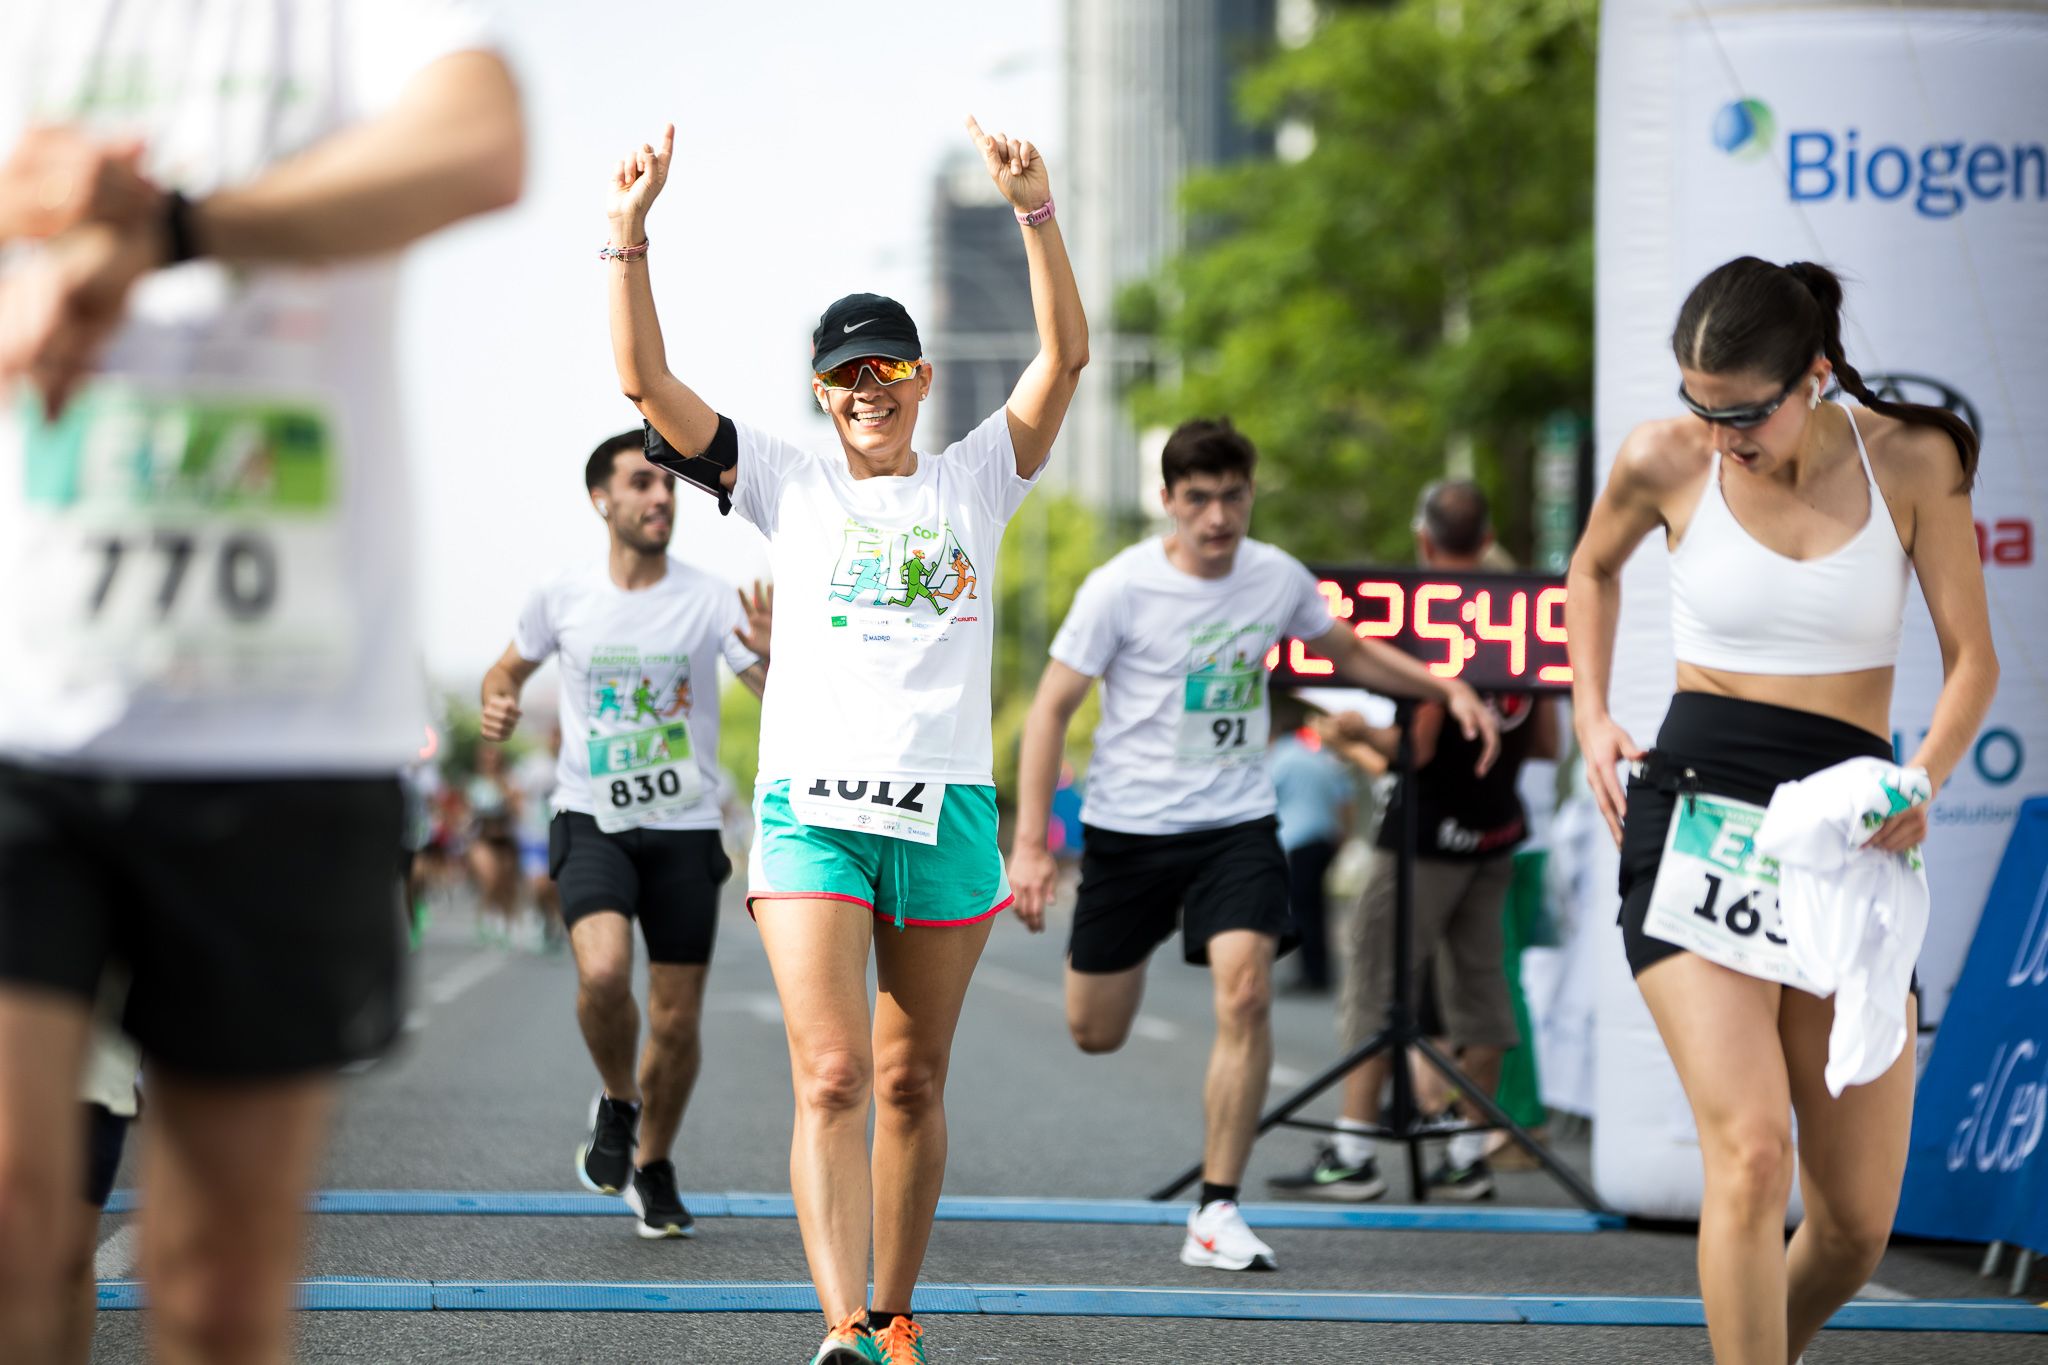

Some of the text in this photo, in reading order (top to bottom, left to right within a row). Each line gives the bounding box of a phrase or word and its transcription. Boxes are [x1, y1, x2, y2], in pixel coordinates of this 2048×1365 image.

[1787, 129, 2048, 219] Biogen
[84, 532, 279, 622] 770
[1212, 716, 1248, 748] 91
[610, 769, 681, 807] 830
